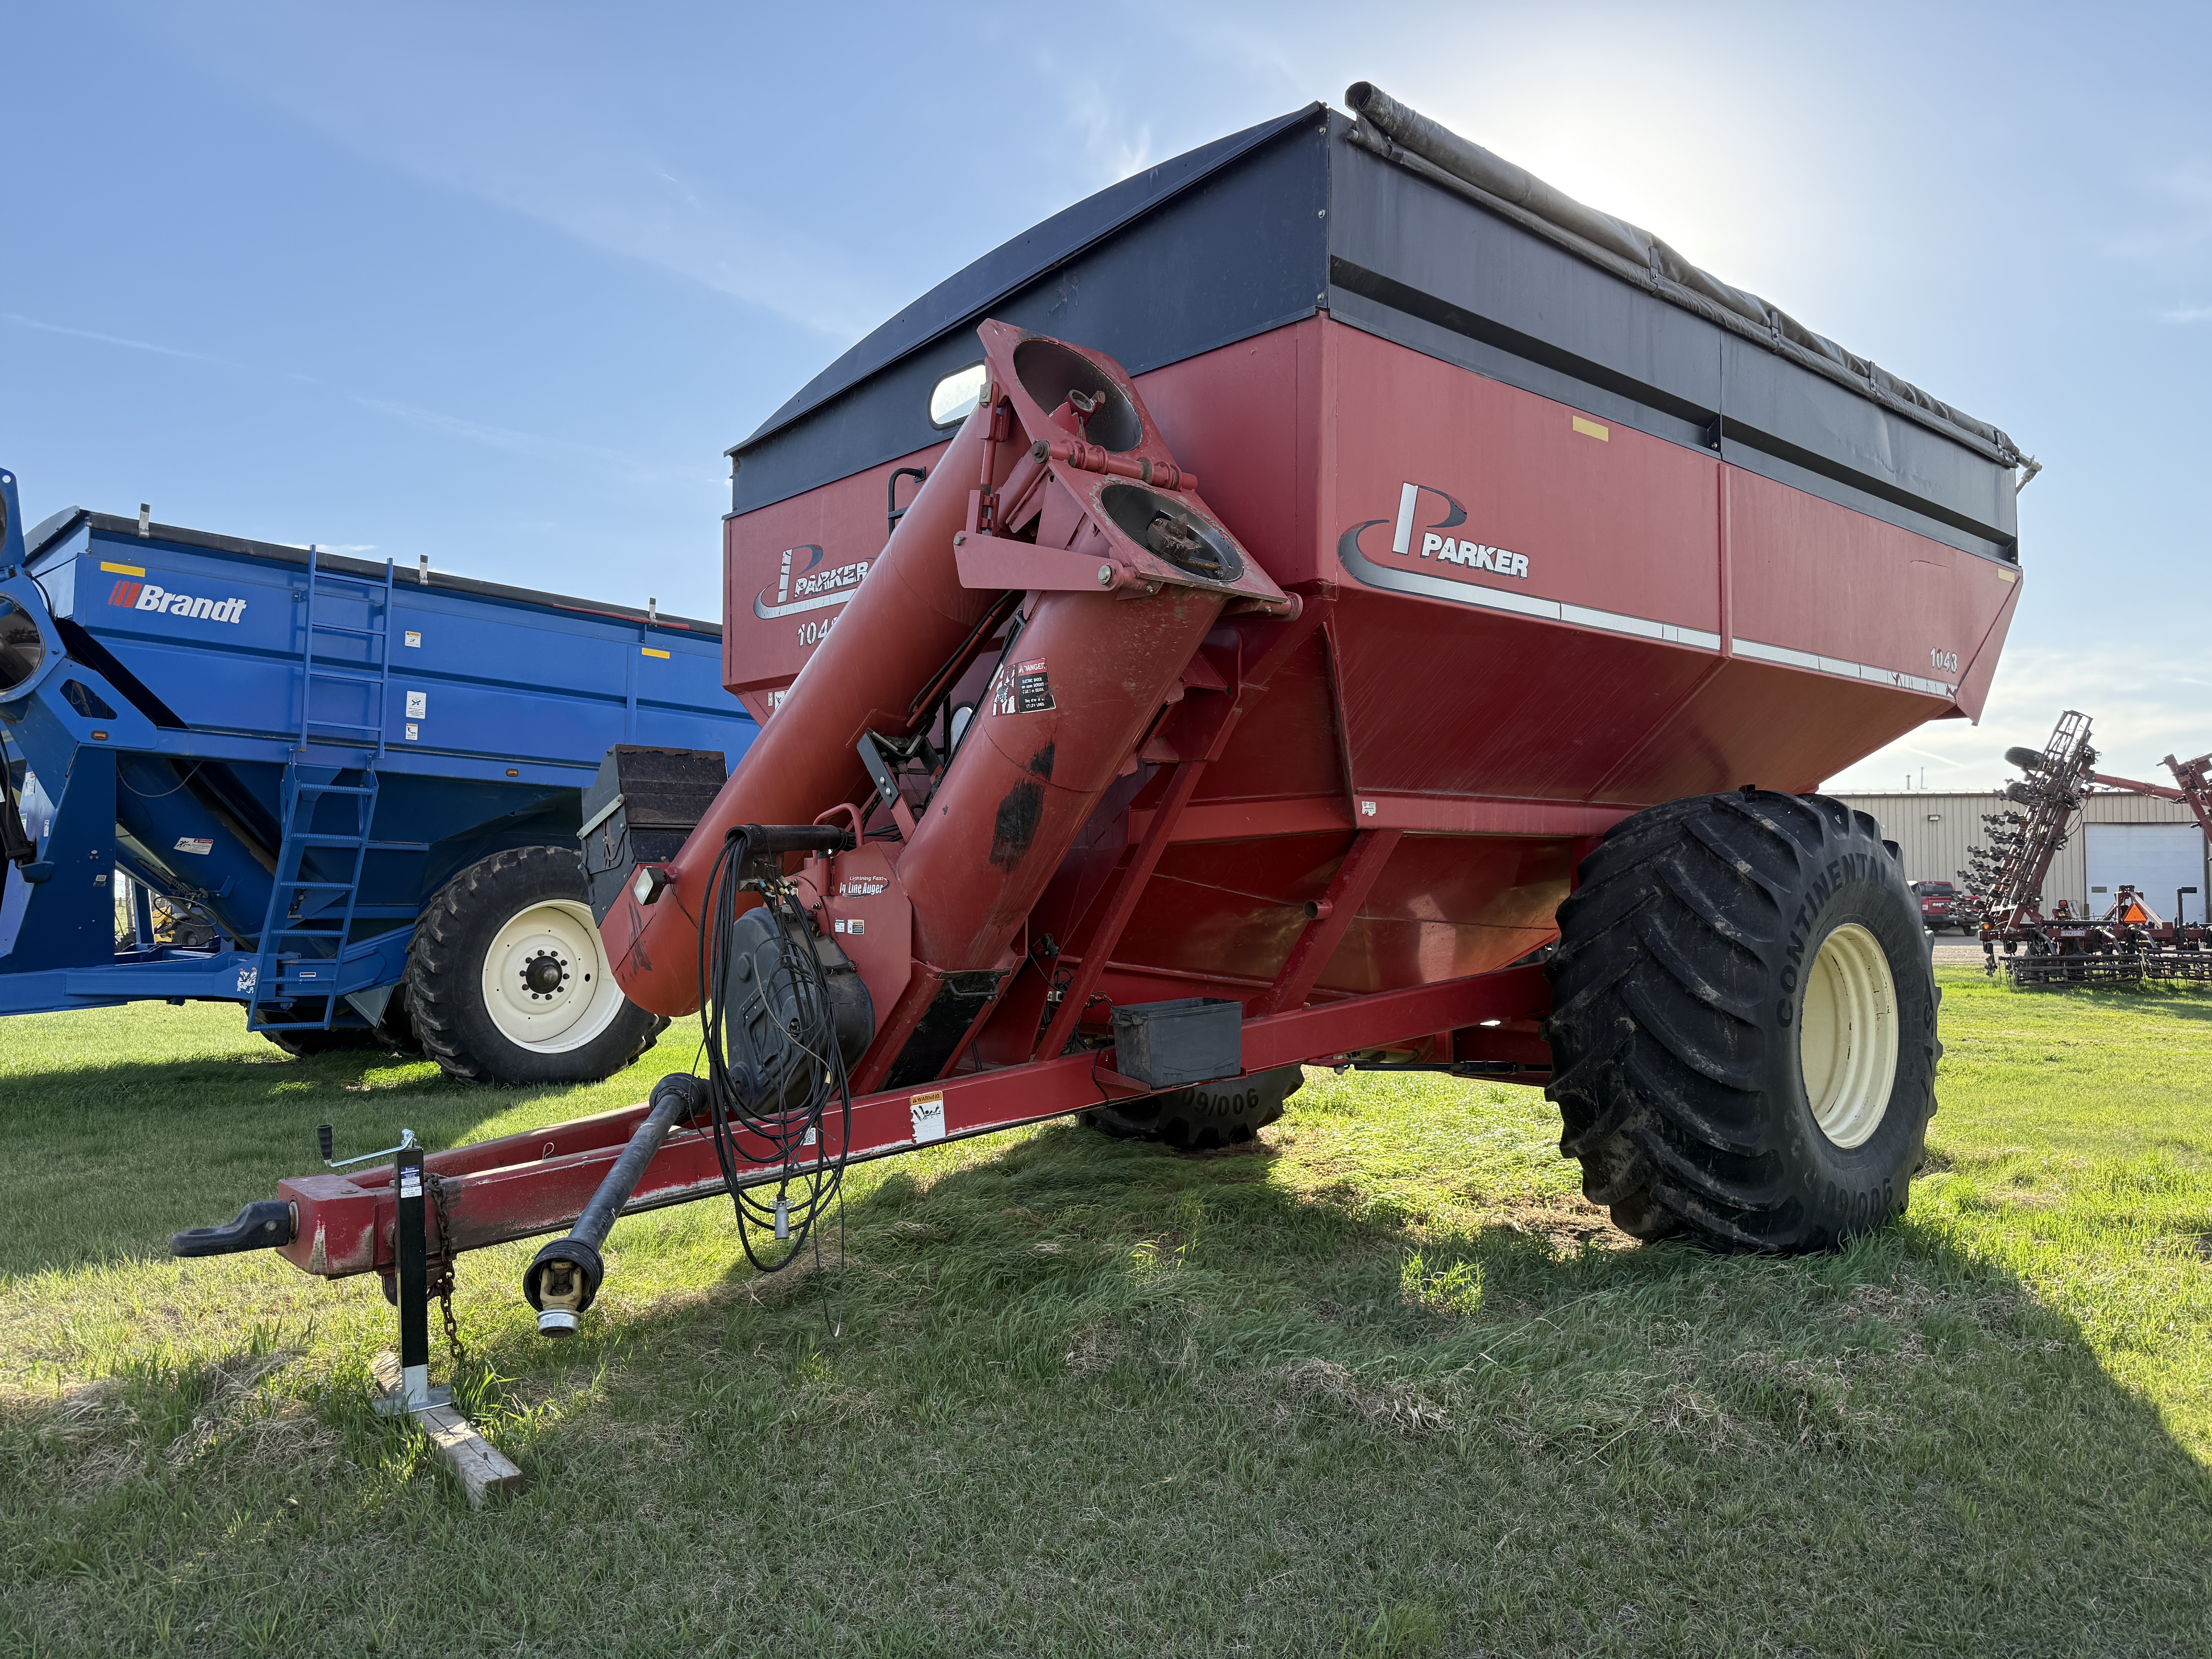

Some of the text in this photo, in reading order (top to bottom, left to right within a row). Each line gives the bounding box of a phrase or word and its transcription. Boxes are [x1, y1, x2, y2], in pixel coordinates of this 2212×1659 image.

[1420, 532, 1529, 579] PARKER
[794, 562, 869, 599] PARKER
[136, 584, 247, 623] Brandt
[1024, 662, 1046, 671] DANGER
[840, 882, 884, 895] In Line Auger
[1776, 853, 1886, 1028] CONTINENTAL
[917, 1094, 940, 1102] WARNING
[1181, 1087, 1259, 1118] 900/60
